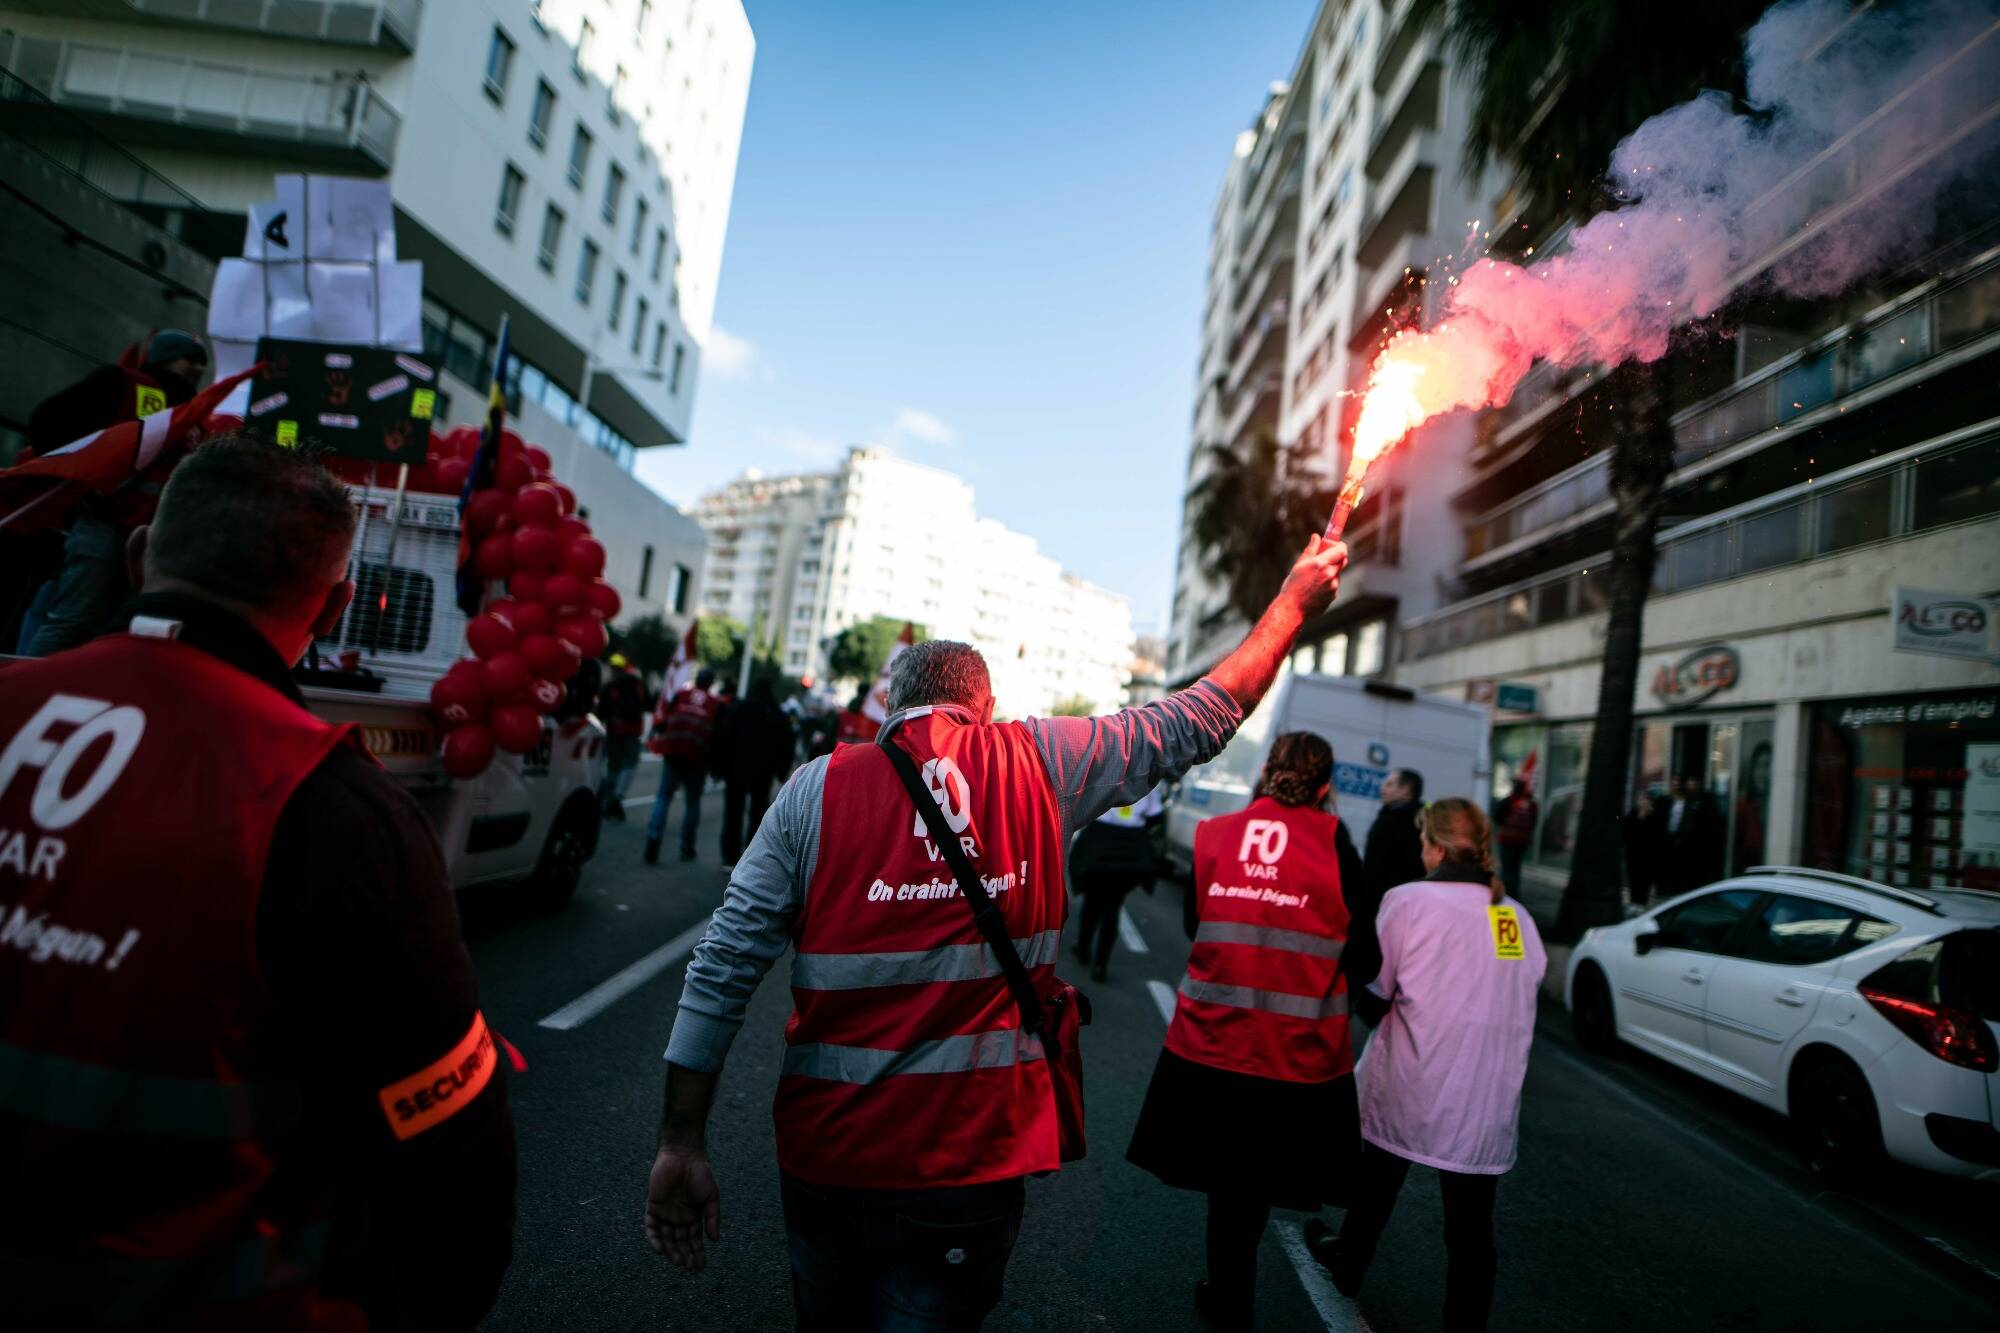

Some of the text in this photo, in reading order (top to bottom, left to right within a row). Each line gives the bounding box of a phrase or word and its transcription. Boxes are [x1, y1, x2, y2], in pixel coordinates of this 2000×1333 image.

[1840, 706, 1904, 729] Agence
[0, 693, 146, 830] FO
[924, 836, 980, 862] VR
[1238, 820, 1289, 864] FO
[867, 860, 1028, 901] On craint égun !
[1243, 863, 1279, 881] VAR
[1208, 882, 1226, 896] On
[1226, 885, 1262, 900] craint
[1299, 894, 1309, 909] !
[1498, 918, 1518, 944] FO
[106, 928, 141, 972] !
